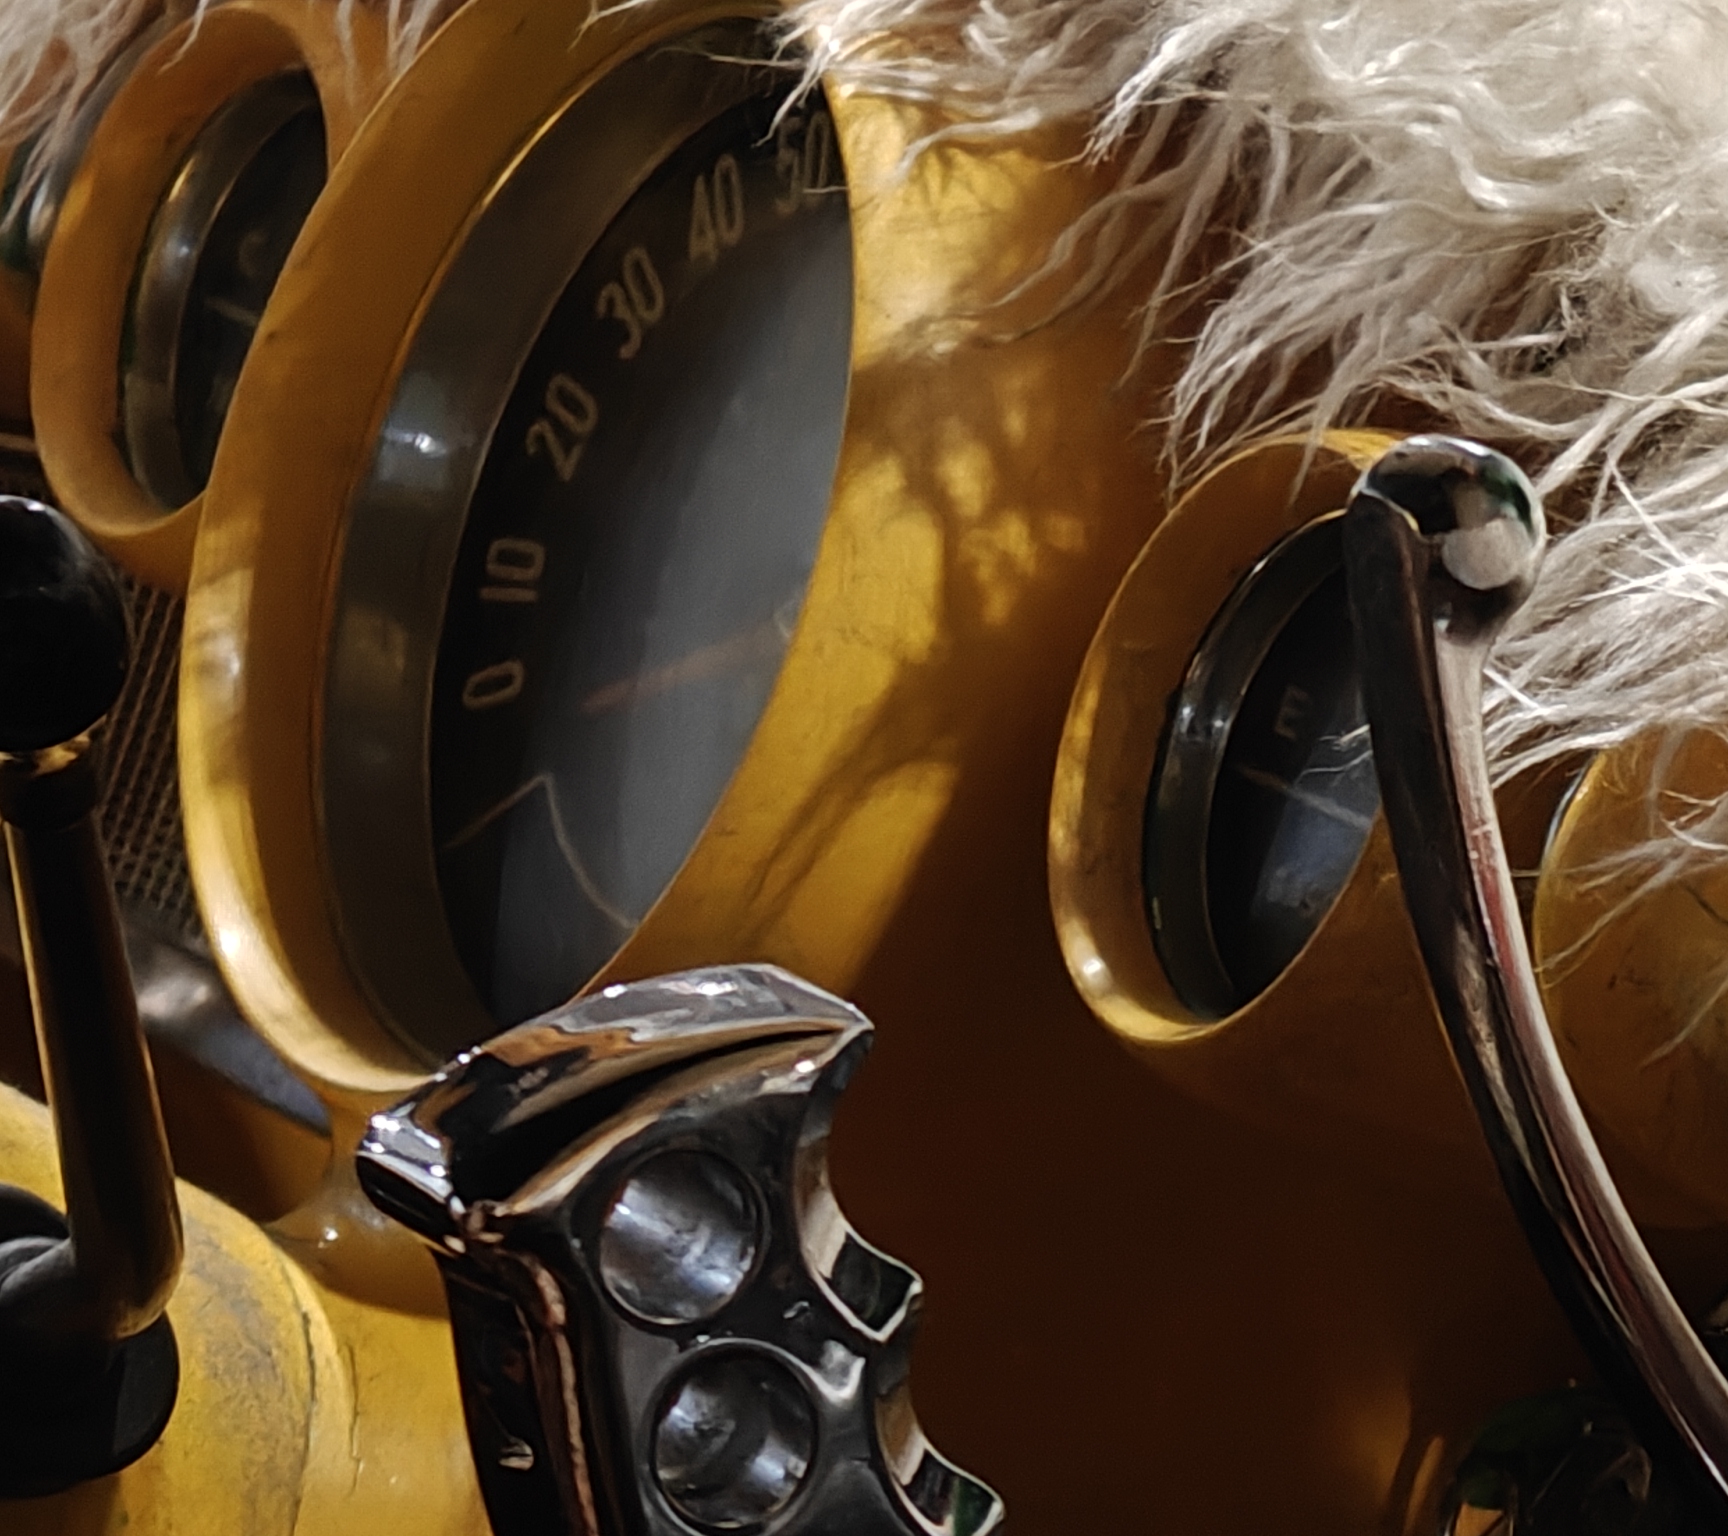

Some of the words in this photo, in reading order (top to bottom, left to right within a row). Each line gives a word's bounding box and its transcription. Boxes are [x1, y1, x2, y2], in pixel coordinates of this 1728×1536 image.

[688, 153, 745, 274] 40
[595, 246, 665, 360] 30
[525, 372, 598, 482] 20
[477, 536, 547, 603] 10
[461, 658, 525, 711] 0
